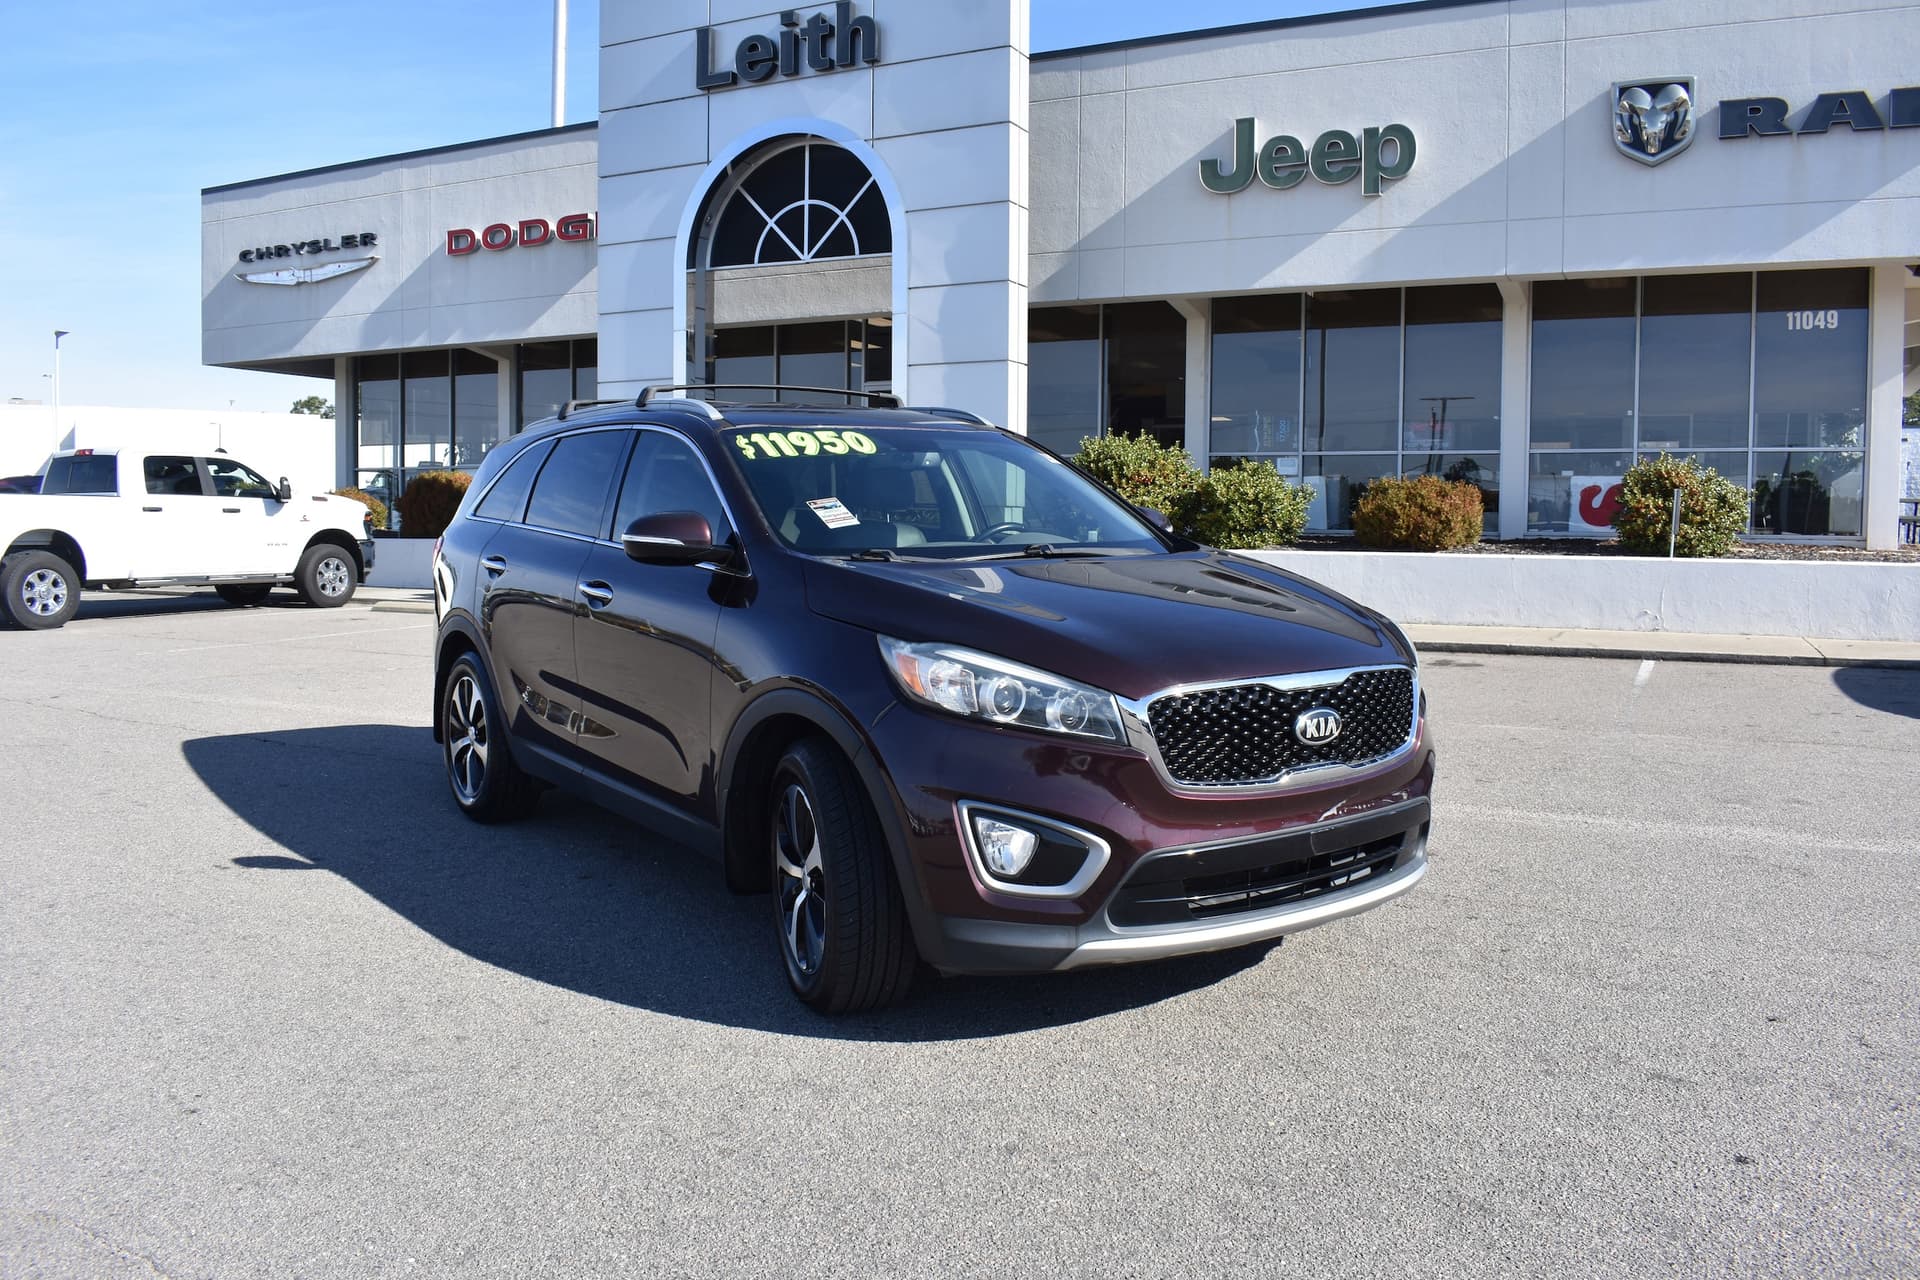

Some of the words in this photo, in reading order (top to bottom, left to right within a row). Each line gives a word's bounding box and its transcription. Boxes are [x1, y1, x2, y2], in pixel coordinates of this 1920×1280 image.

[696, 1, 881, 90] Leith
[1199, 116, 1417, 197] Jeep
[239, 232, 378, 263] CHRYSLER
[446, 211, 598, 255] DODG
[1786, 310, 1839, 330] 11049
[736, 430, 877, 460] $11950
[1305, 715, 1337, 739] KIA
